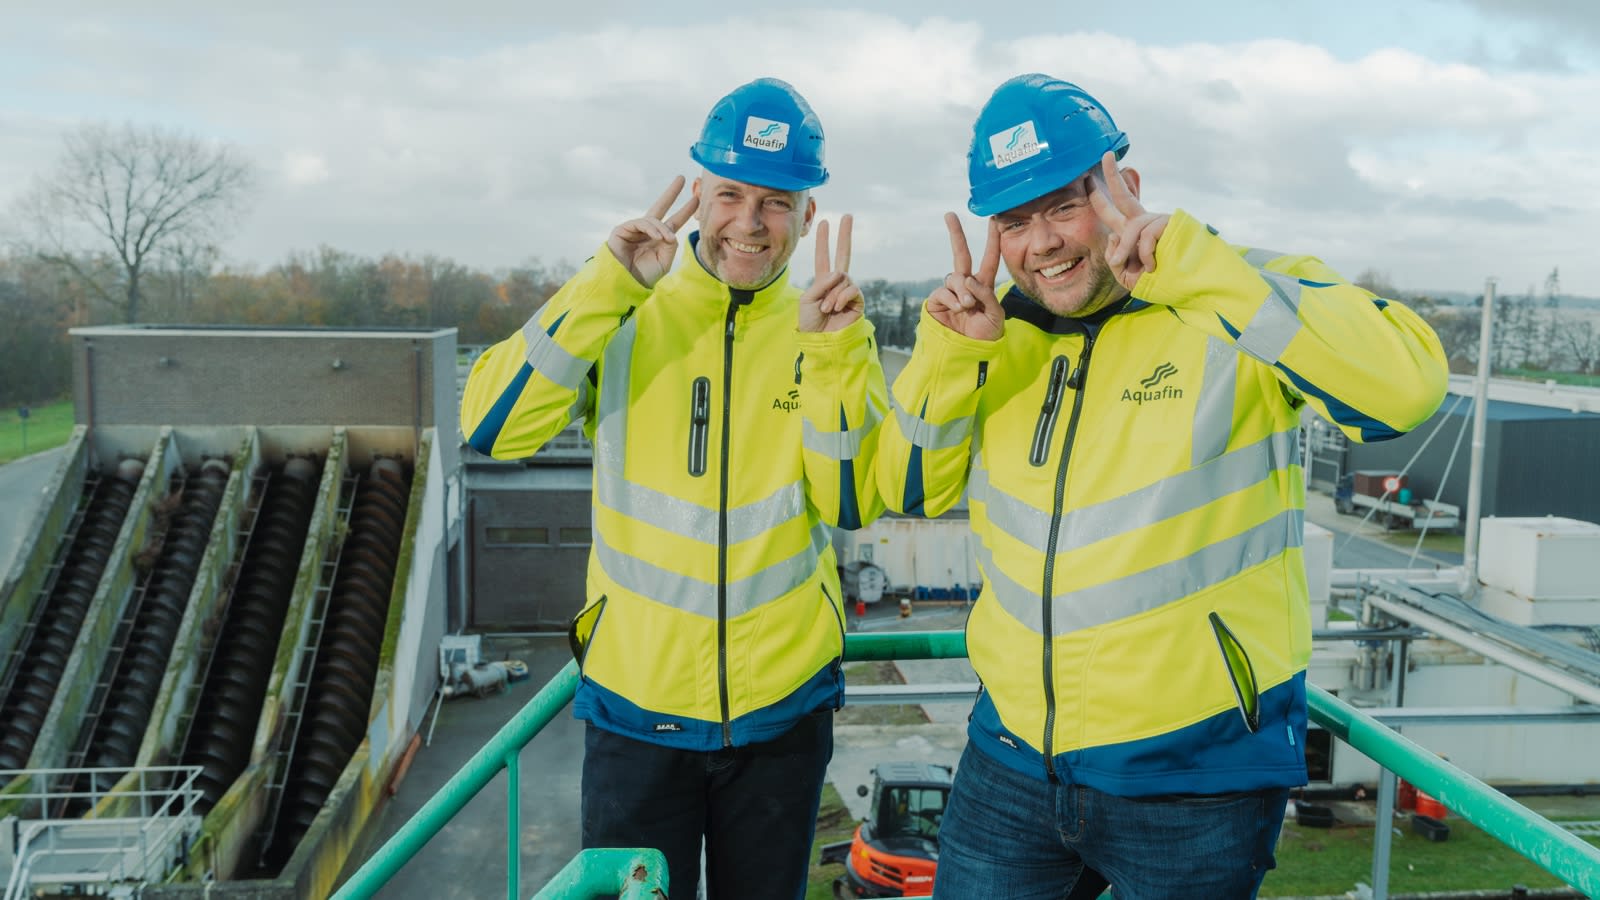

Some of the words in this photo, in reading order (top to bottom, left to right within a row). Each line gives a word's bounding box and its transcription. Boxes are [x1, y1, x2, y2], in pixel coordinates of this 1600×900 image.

[745, 134, 785, 149] Aquafin
[997, 142, 1038, 165] Aquafin
[1121, 385, 1183, 406] Aquafin
[772, 398, 801, 413] Aqu
